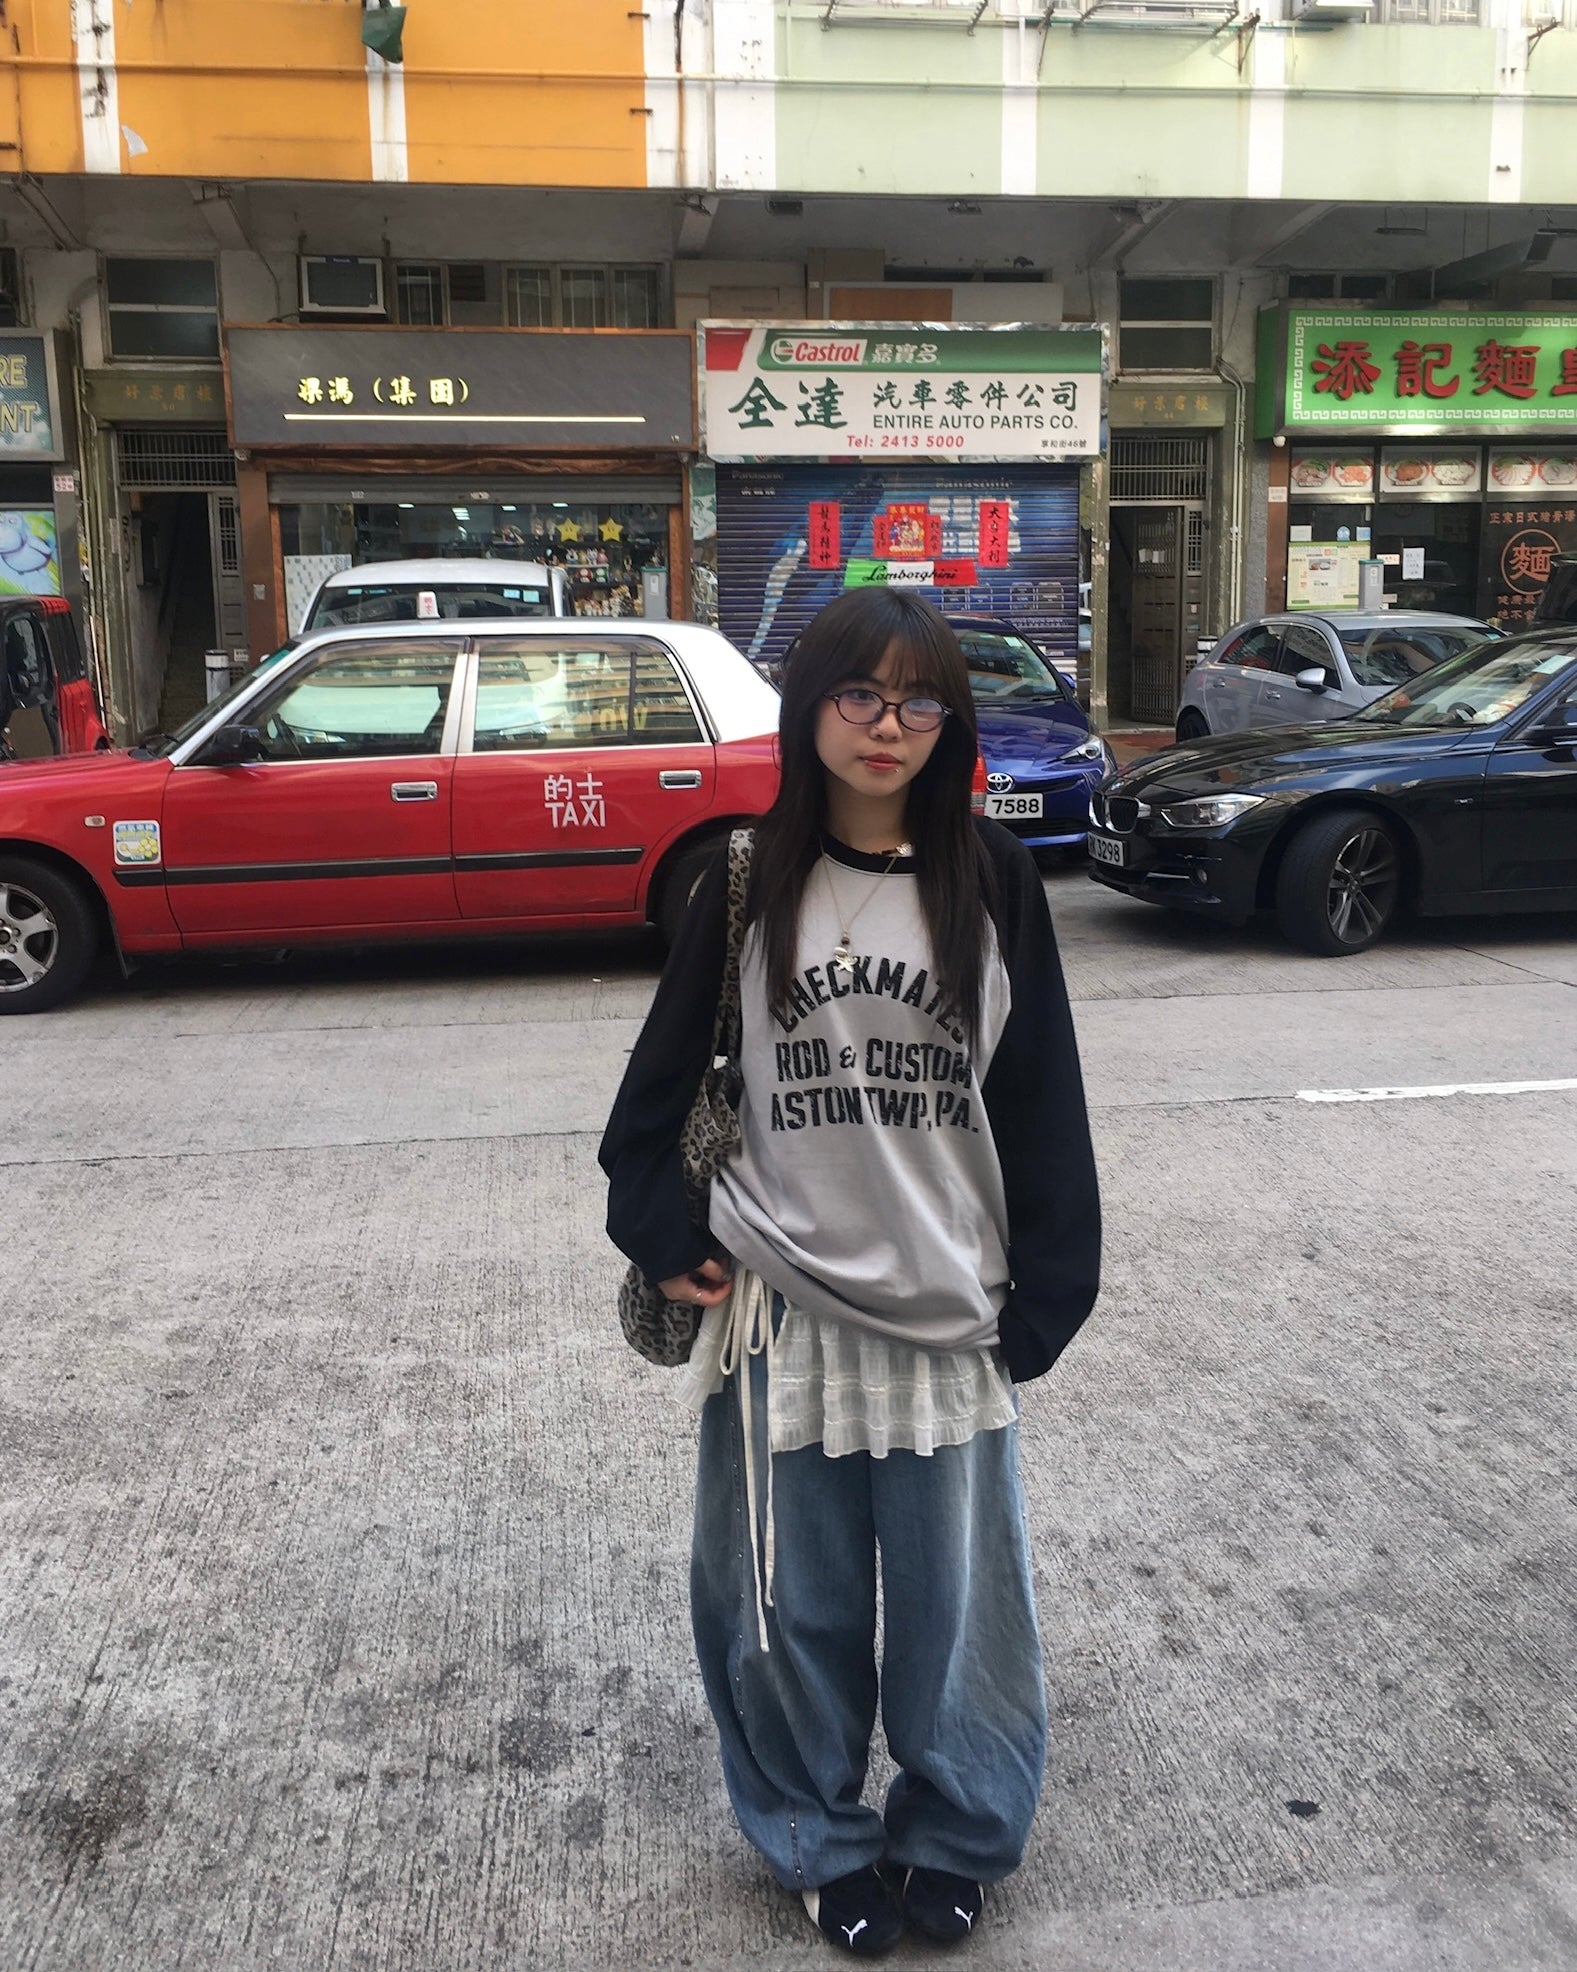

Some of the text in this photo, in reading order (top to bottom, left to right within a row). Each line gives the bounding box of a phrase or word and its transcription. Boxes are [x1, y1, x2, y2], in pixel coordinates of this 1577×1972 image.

[795, 342, 860, 363] Castrol
[728, 377, 1078, 429] 全達 汽車零件公司
[0, 402, 38, 433] NT
[873, 414, 1078, 429] ENTIRE AUTO PARTS CO.
[847, 434, 964, 448] Tel: 2413 5000
[862, 565, 958, 584] Lamborghini
[1508, 541, 1555, 582] 麵
[543, 772, 604, 801] 的士
[544, 800, 606, 828] TAXI
[992, 798, 1039, 815] 7588
[1097, 838, 1121, 863] 3298
[775, 1038, 972, 1089] ROD & CUSTOM
[771, 1086, 864, 1132] ASTON
[935, 1090, 979, 1133] PA.
